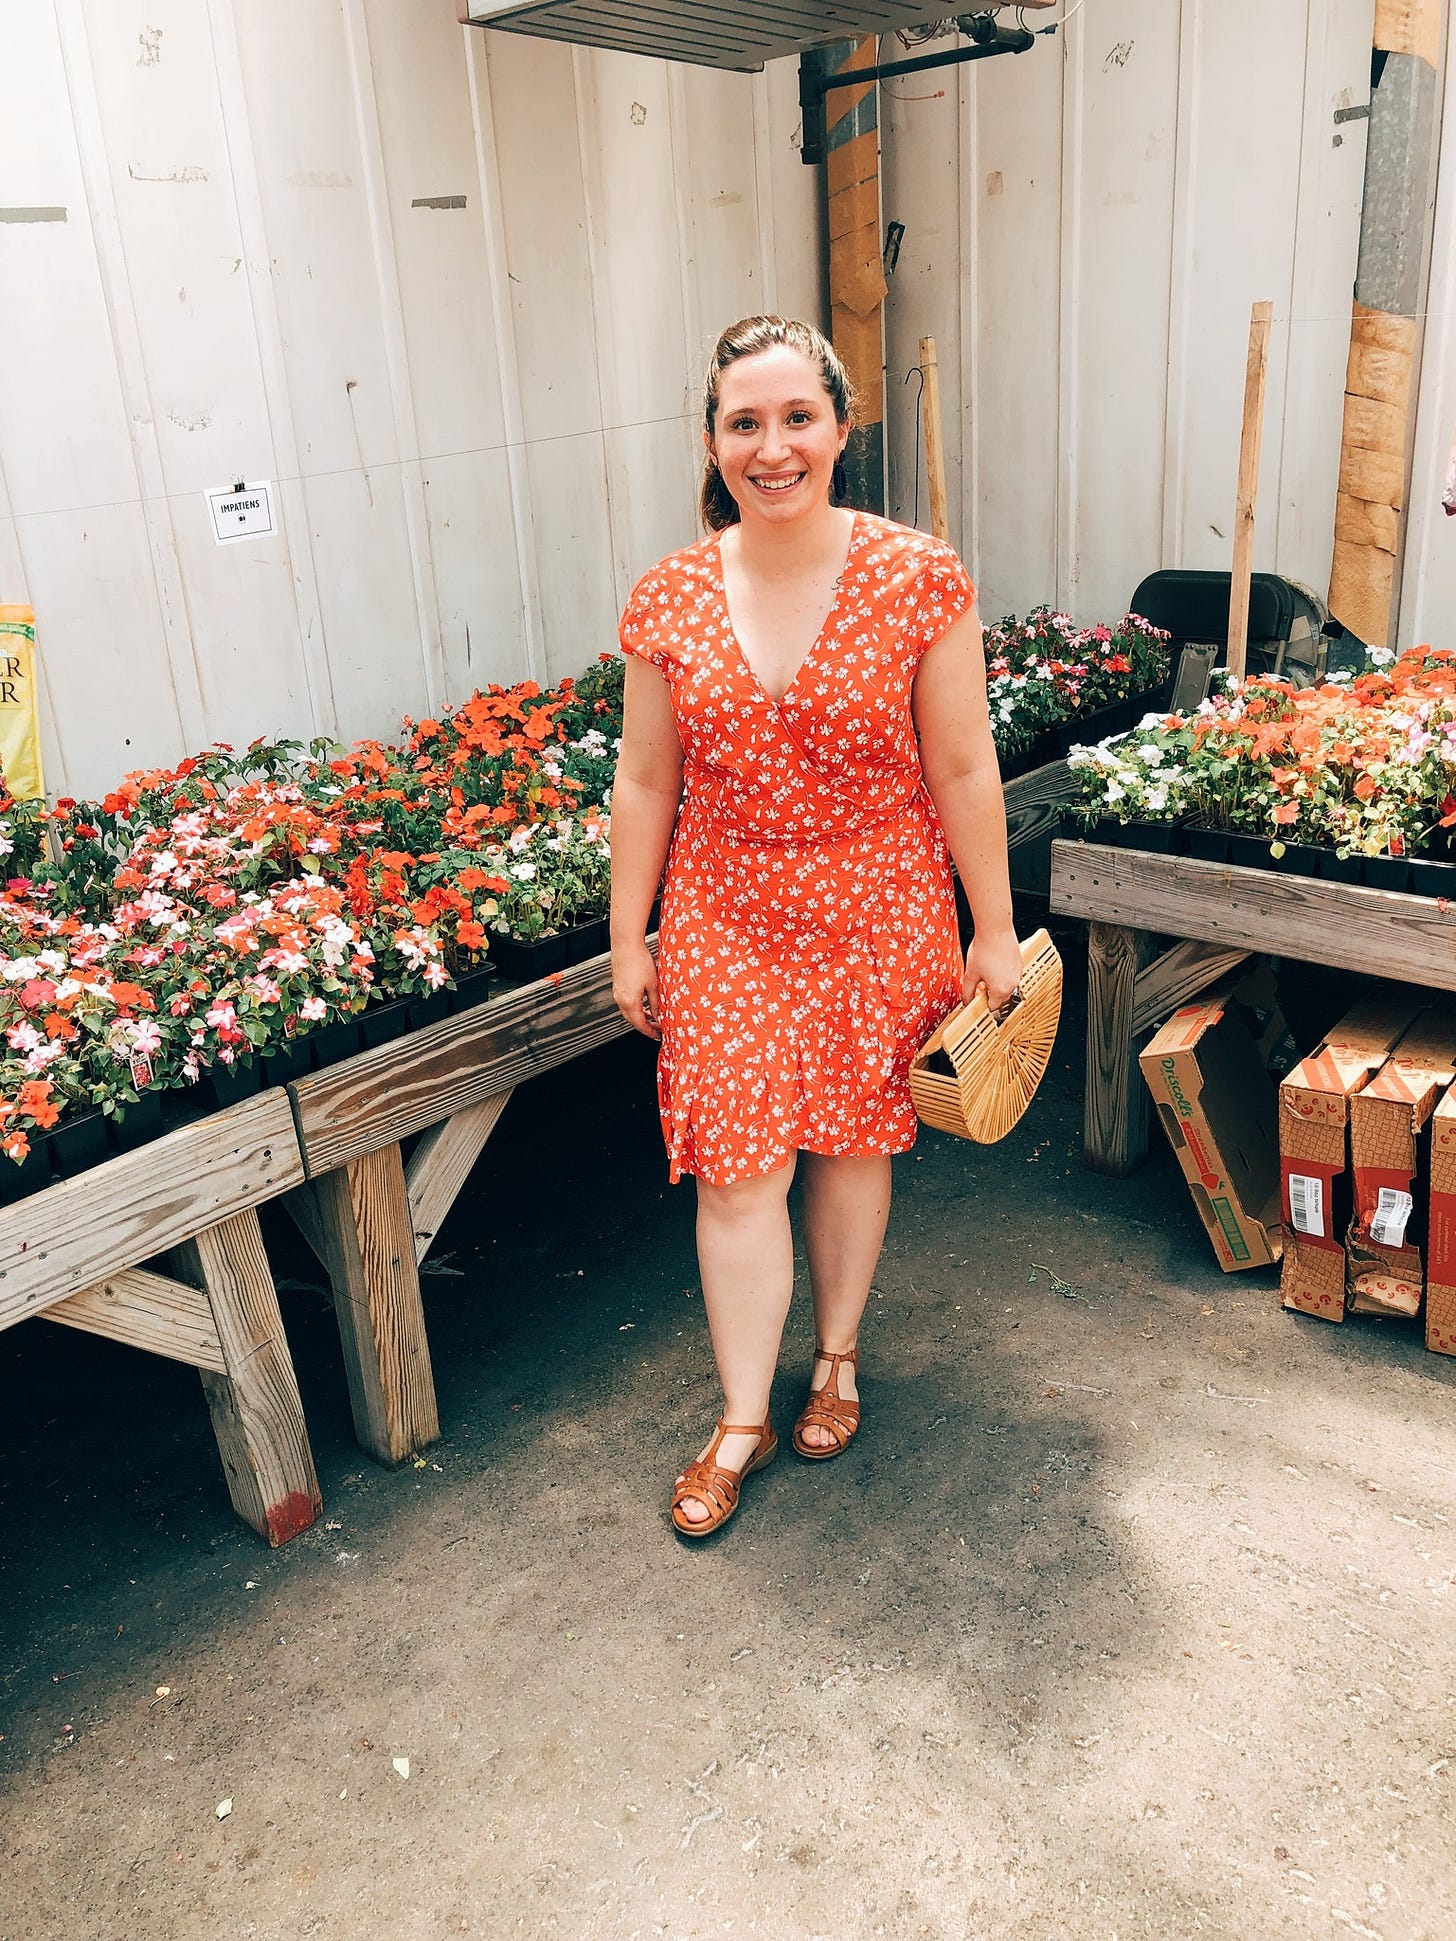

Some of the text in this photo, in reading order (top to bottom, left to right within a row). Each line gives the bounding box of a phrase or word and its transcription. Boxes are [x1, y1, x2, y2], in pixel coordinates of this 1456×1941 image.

[220, 499, 260, 513] IMPATIENS
[0, 656, 24, 678] R
[1160, 1056, 1193, 1118] Driscoll's
